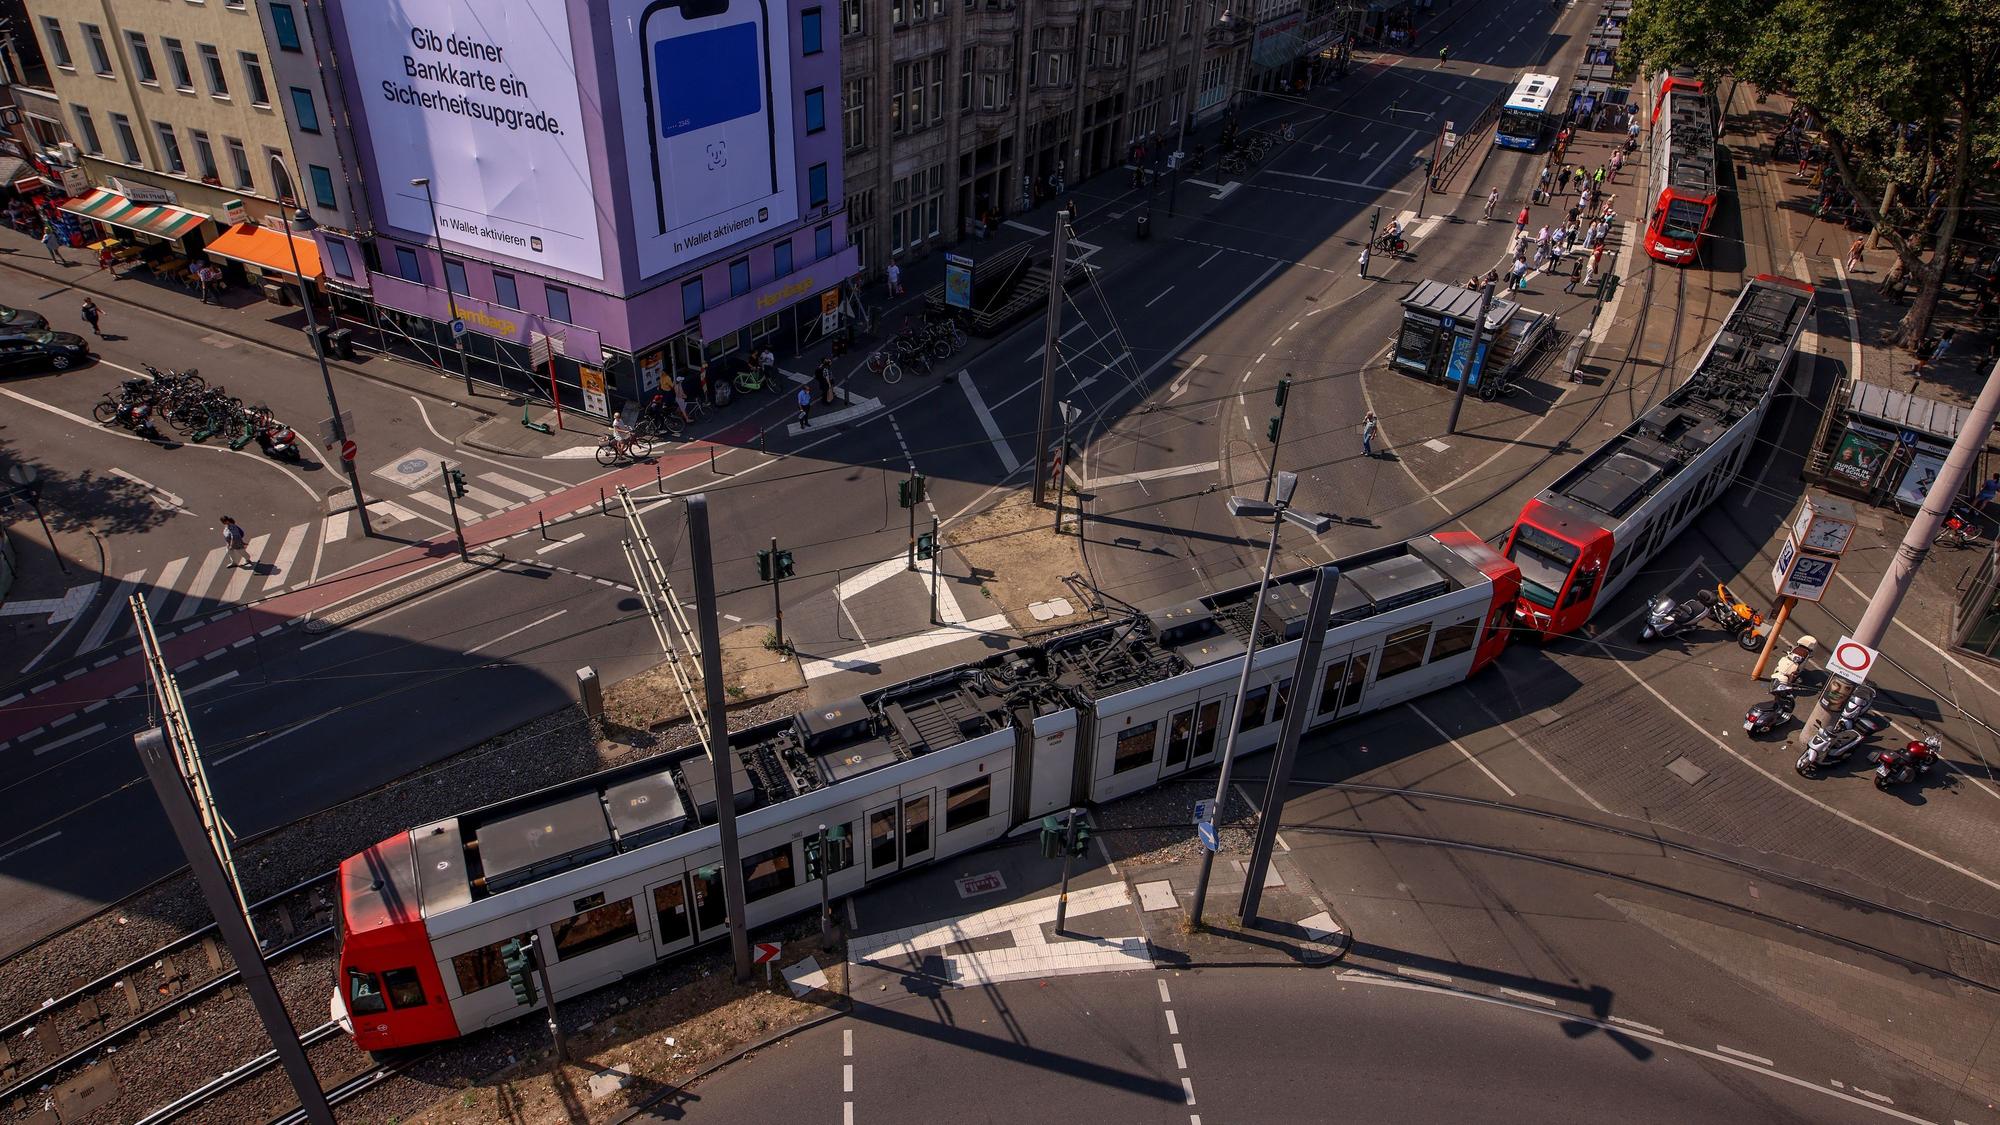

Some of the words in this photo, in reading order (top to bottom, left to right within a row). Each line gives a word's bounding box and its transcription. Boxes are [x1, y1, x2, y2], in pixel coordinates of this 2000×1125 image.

[411, 27, 442, 53] Gib
[447, 34, 503, 63] deiner
[403, 55, 496, 92] Bankkarte
[500, 74, 528, 98] ein
[382, 80, 564, 135] Sicherheitsupgrade.
[440, 216, 449, 227] In
[450, 218, 478, 235] Wallet
[480, 227, 526, 247] aktivieren
[673, 242, 682, 253] In
[684, 232, 712, 249] Wallet
[713, 216, 754, 239] aktivieren
[1444, 318, 1452, 327] U
[1903, 431, 1915, 443] U
